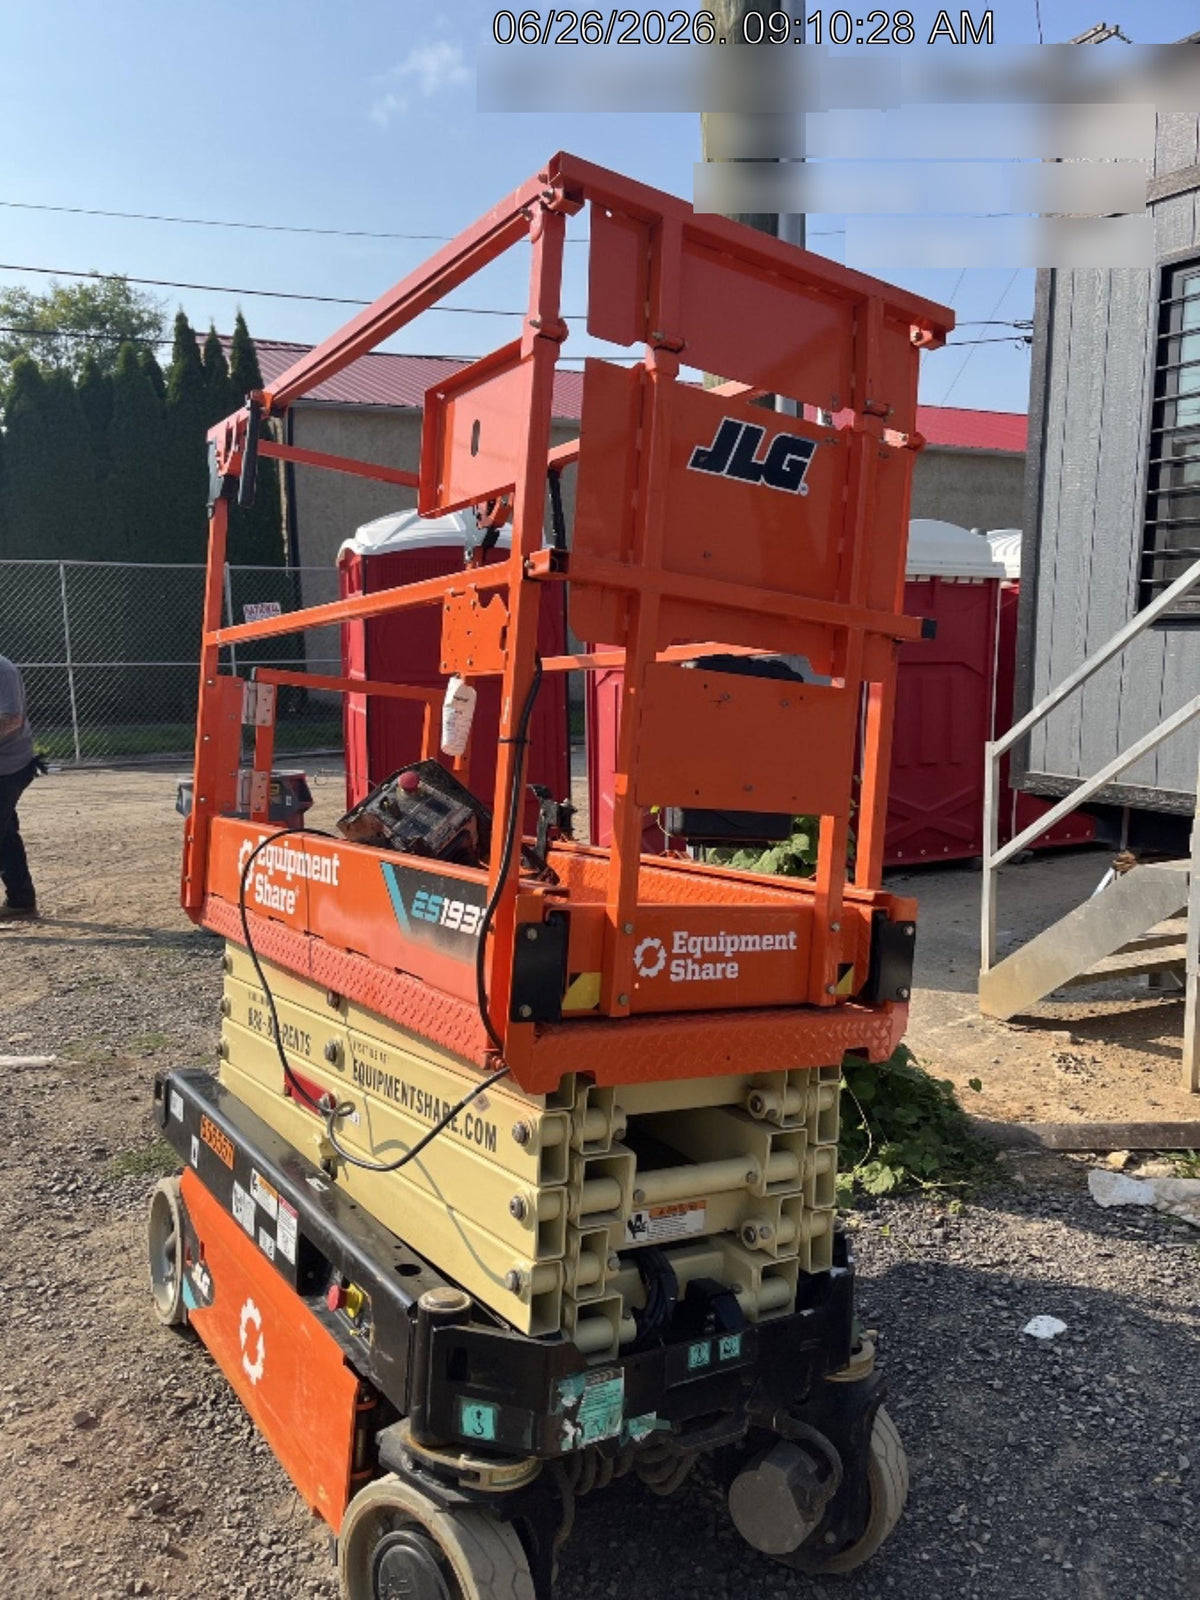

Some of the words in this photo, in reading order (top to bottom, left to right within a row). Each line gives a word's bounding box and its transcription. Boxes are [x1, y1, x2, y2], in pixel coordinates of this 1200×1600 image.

[687, 415, 817, 494] JLG
[257, 834, 341, 887] Equipment
[254, 873, 297, 915] Share
[671, 930, 797, 957] Equipment
[669, 958, 739, 982] Share
